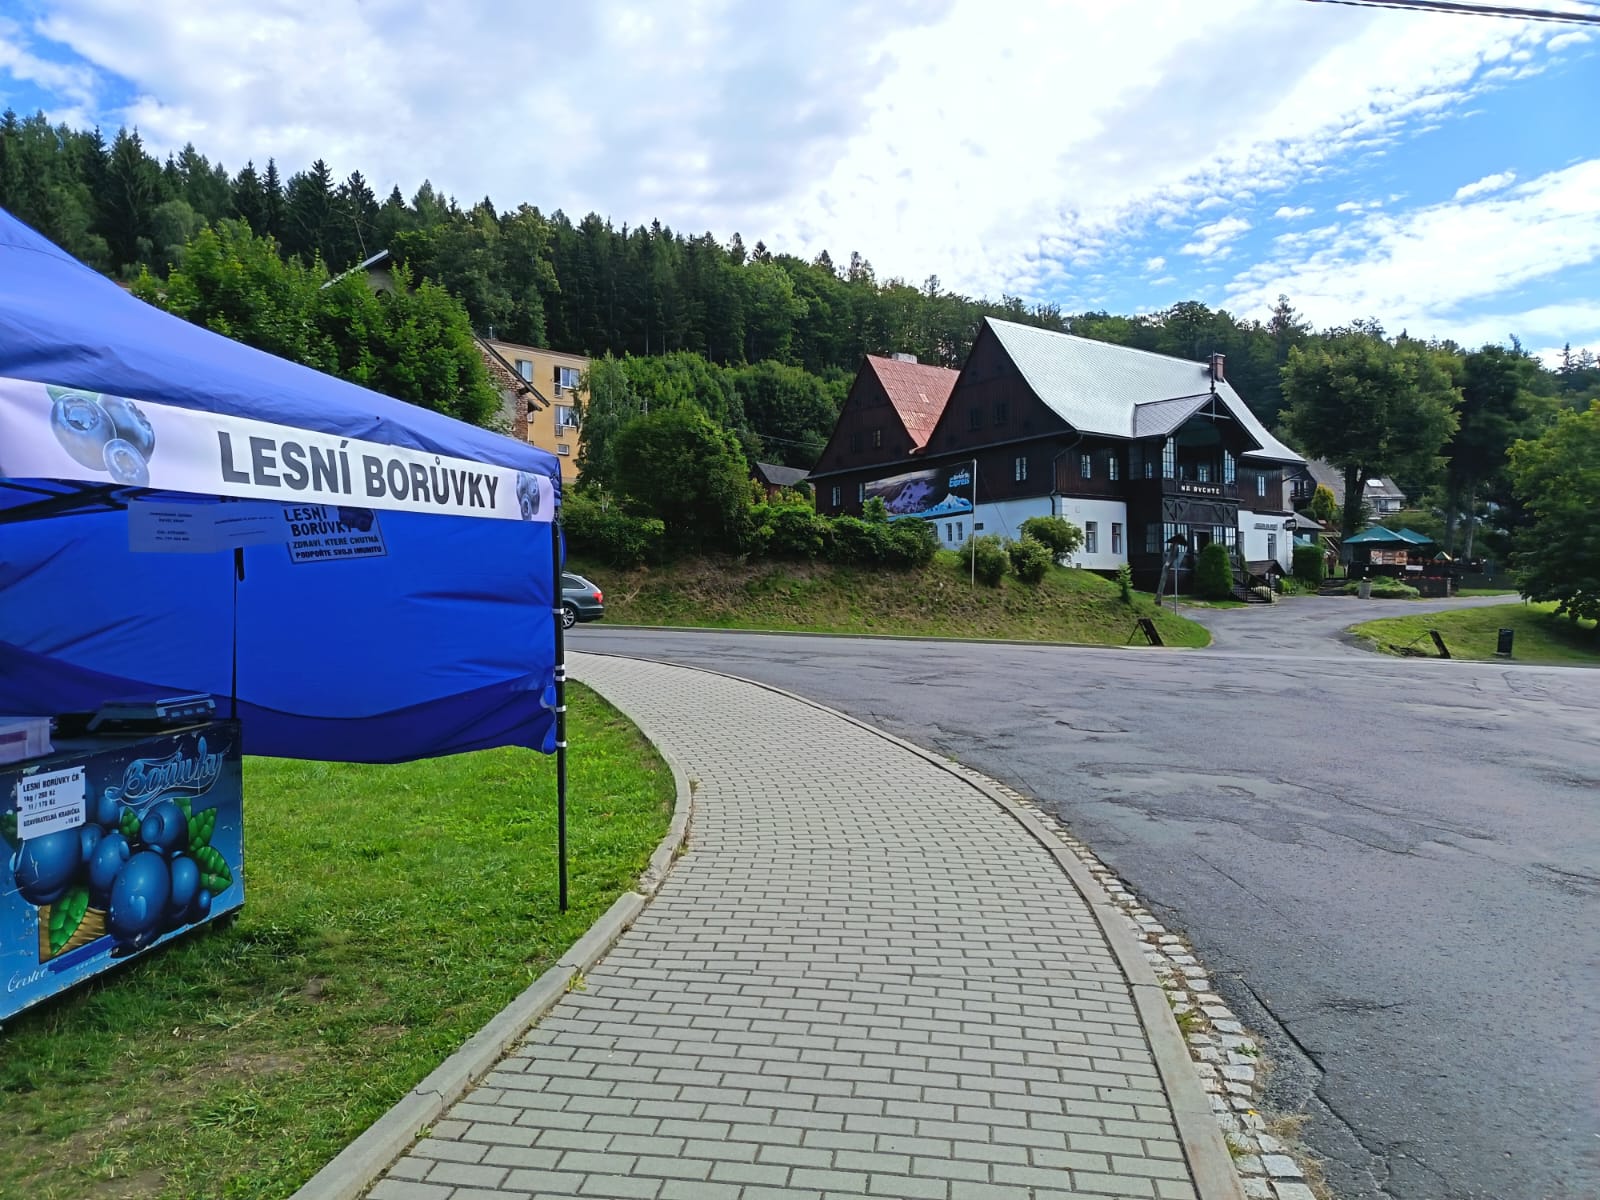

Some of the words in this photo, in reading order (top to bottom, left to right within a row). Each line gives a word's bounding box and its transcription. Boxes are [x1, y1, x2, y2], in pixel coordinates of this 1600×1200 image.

[217, 430, 352, 495] LESNÍ
[363, 455, 499, 509] BORŮVKY
[42, 775, 70, 788] BORŮVKY
